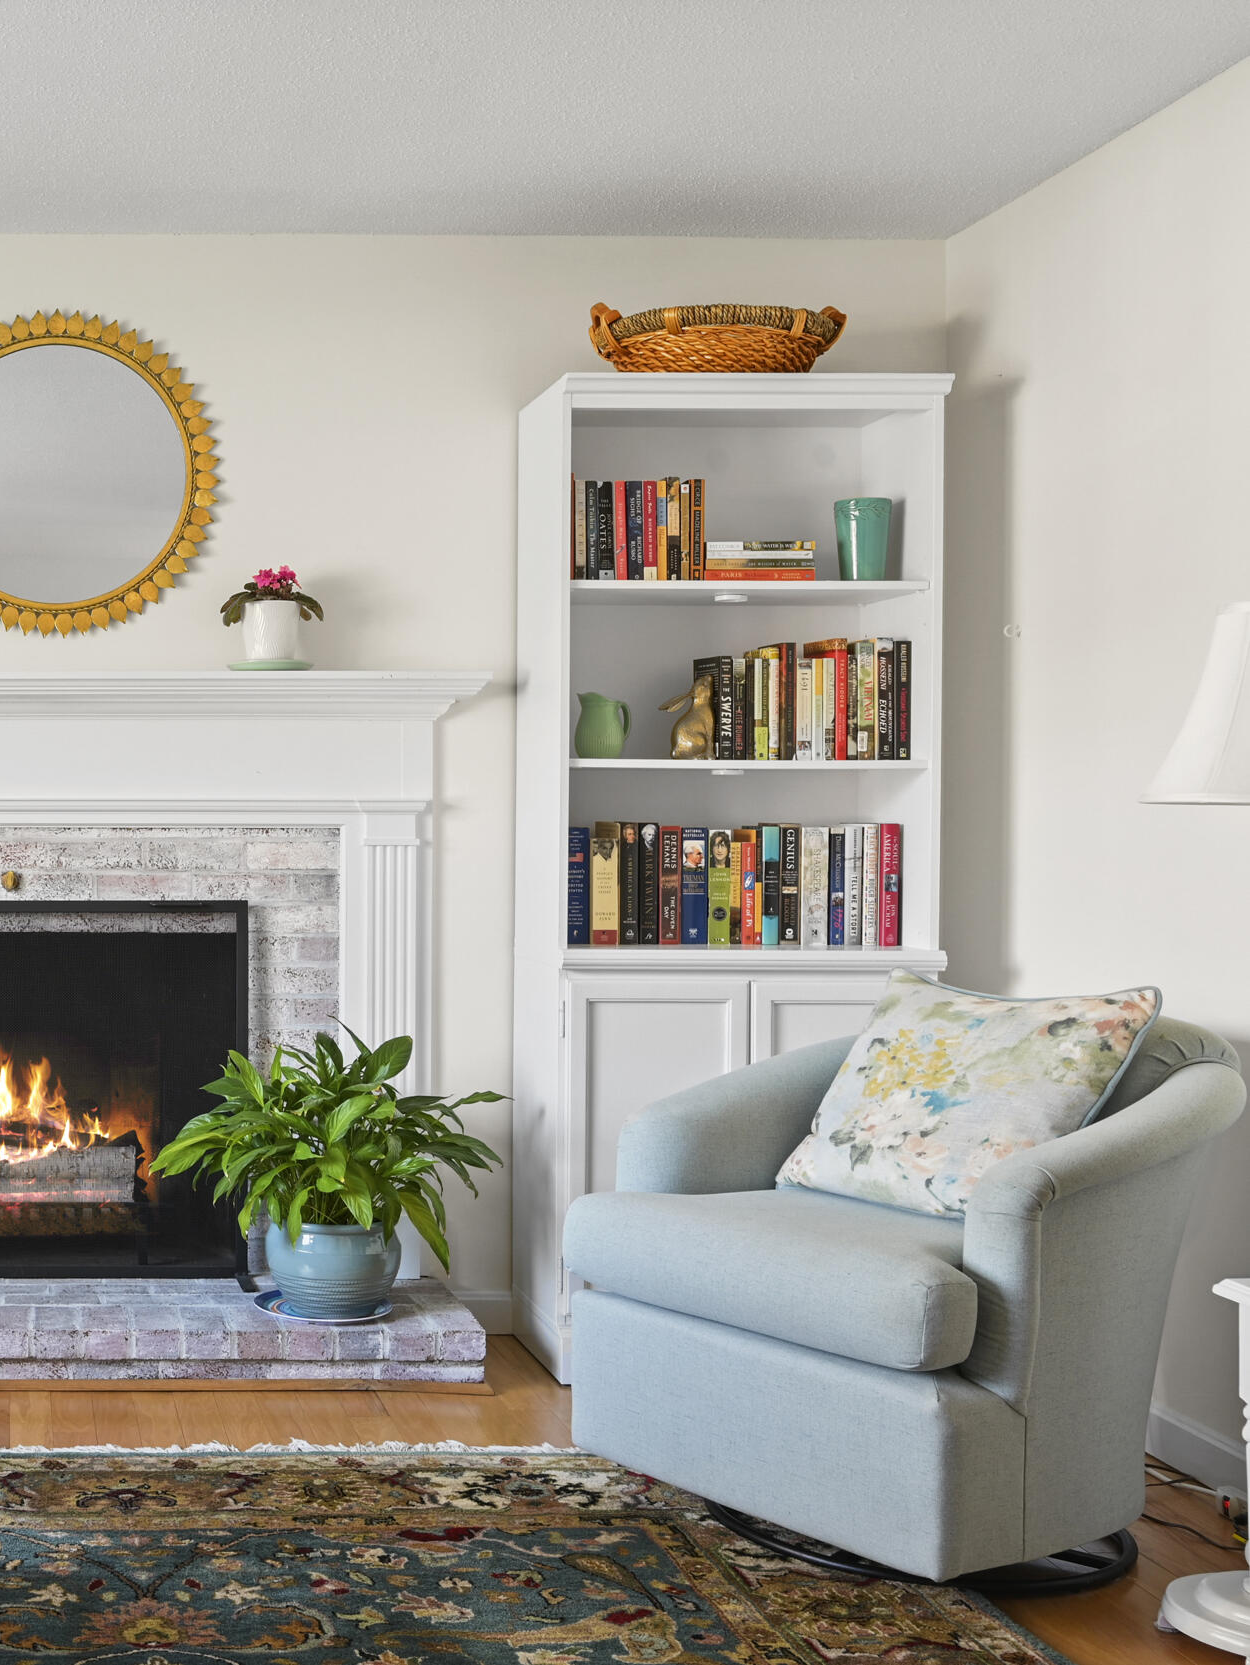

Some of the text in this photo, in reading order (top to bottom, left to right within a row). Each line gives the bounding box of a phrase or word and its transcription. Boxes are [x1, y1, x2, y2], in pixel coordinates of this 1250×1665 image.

[636, 516, 641, 524] OF
[721, 696, 732, 737] SWERVE
[864, 681, 872, 720] VIETNAM
[735, 725, 743, 750] RUNNER
[786, 829, 795, 869] GENIUS
[645, 847, 654, 914] MARK TWAIN
[813, 849, 821, 901] SHAKESPEARE
[851, 895, 858, 903] ME
[746, 919, 753, 927] Pi
